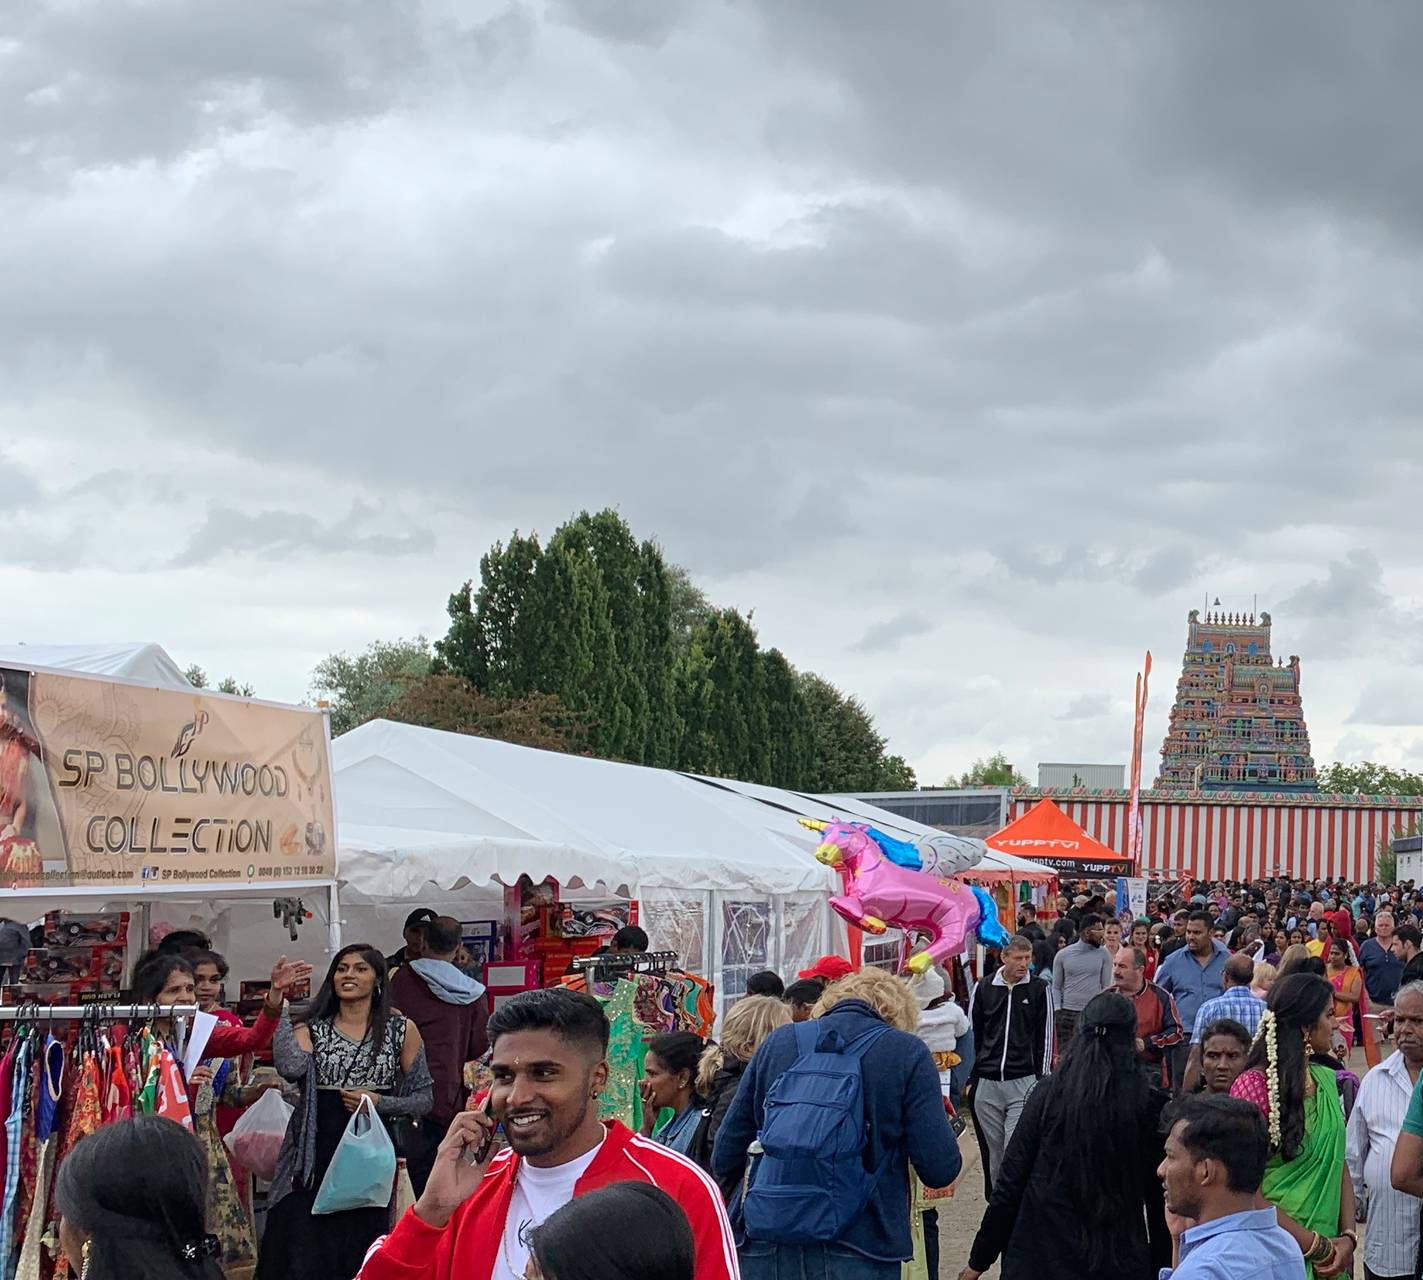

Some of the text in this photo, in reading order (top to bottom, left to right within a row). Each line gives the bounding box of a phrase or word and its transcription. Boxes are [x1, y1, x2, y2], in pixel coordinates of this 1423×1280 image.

[58, 749, 289, 797] SP BOLLYWOOD
[996, 839, 1079, 850] YUPPTV
[1082, 863, 1127, 873] YUPPTV
[161, 869, 172, 880] SP
[173, 869, 208, 881] Bollywood
[209, 868, 241, 879] Collection
